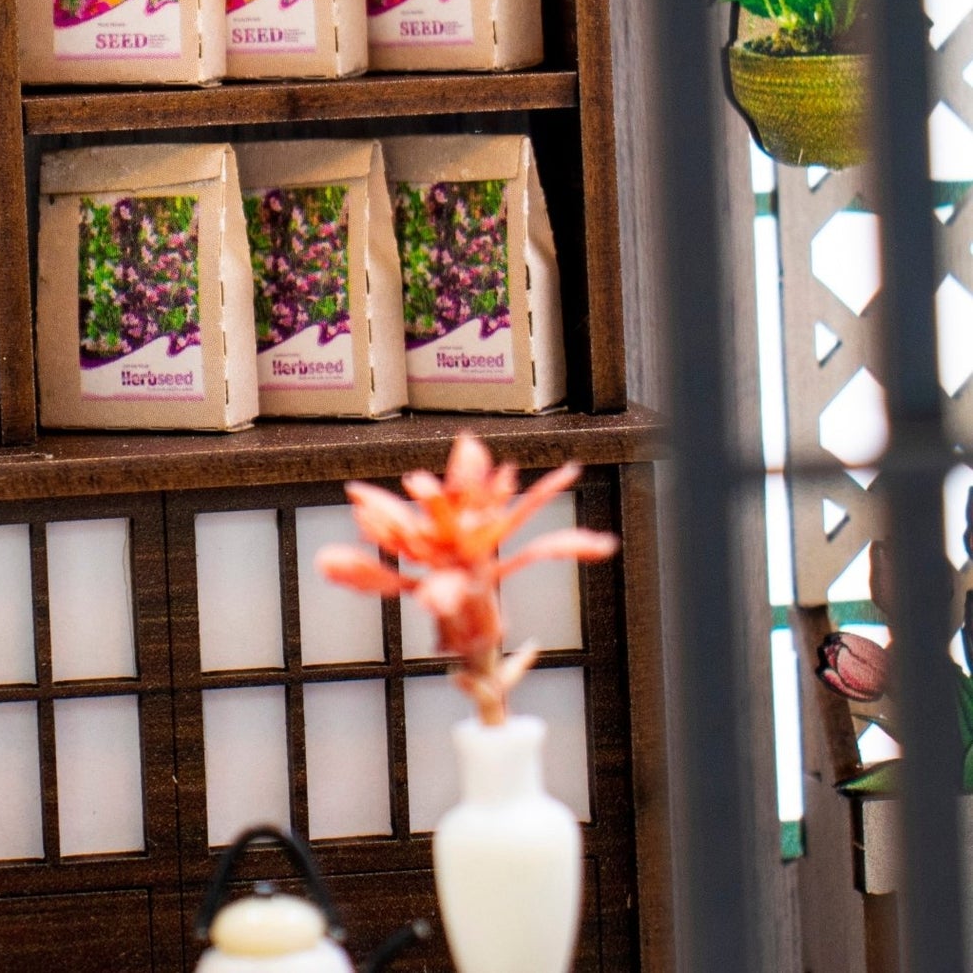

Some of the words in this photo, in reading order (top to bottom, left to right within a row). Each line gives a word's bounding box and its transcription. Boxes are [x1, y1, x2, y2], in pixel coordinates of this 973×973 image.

[231, 27, 284, 44] SEED
[399, 20, 445, 36] SEED
[95, 33, 148, 49] SEED
[272, 358, 345, 375] Herbseed
[436, 351, 505, 368] Herbseed
[121, 370, 194, 386] Herbseed
